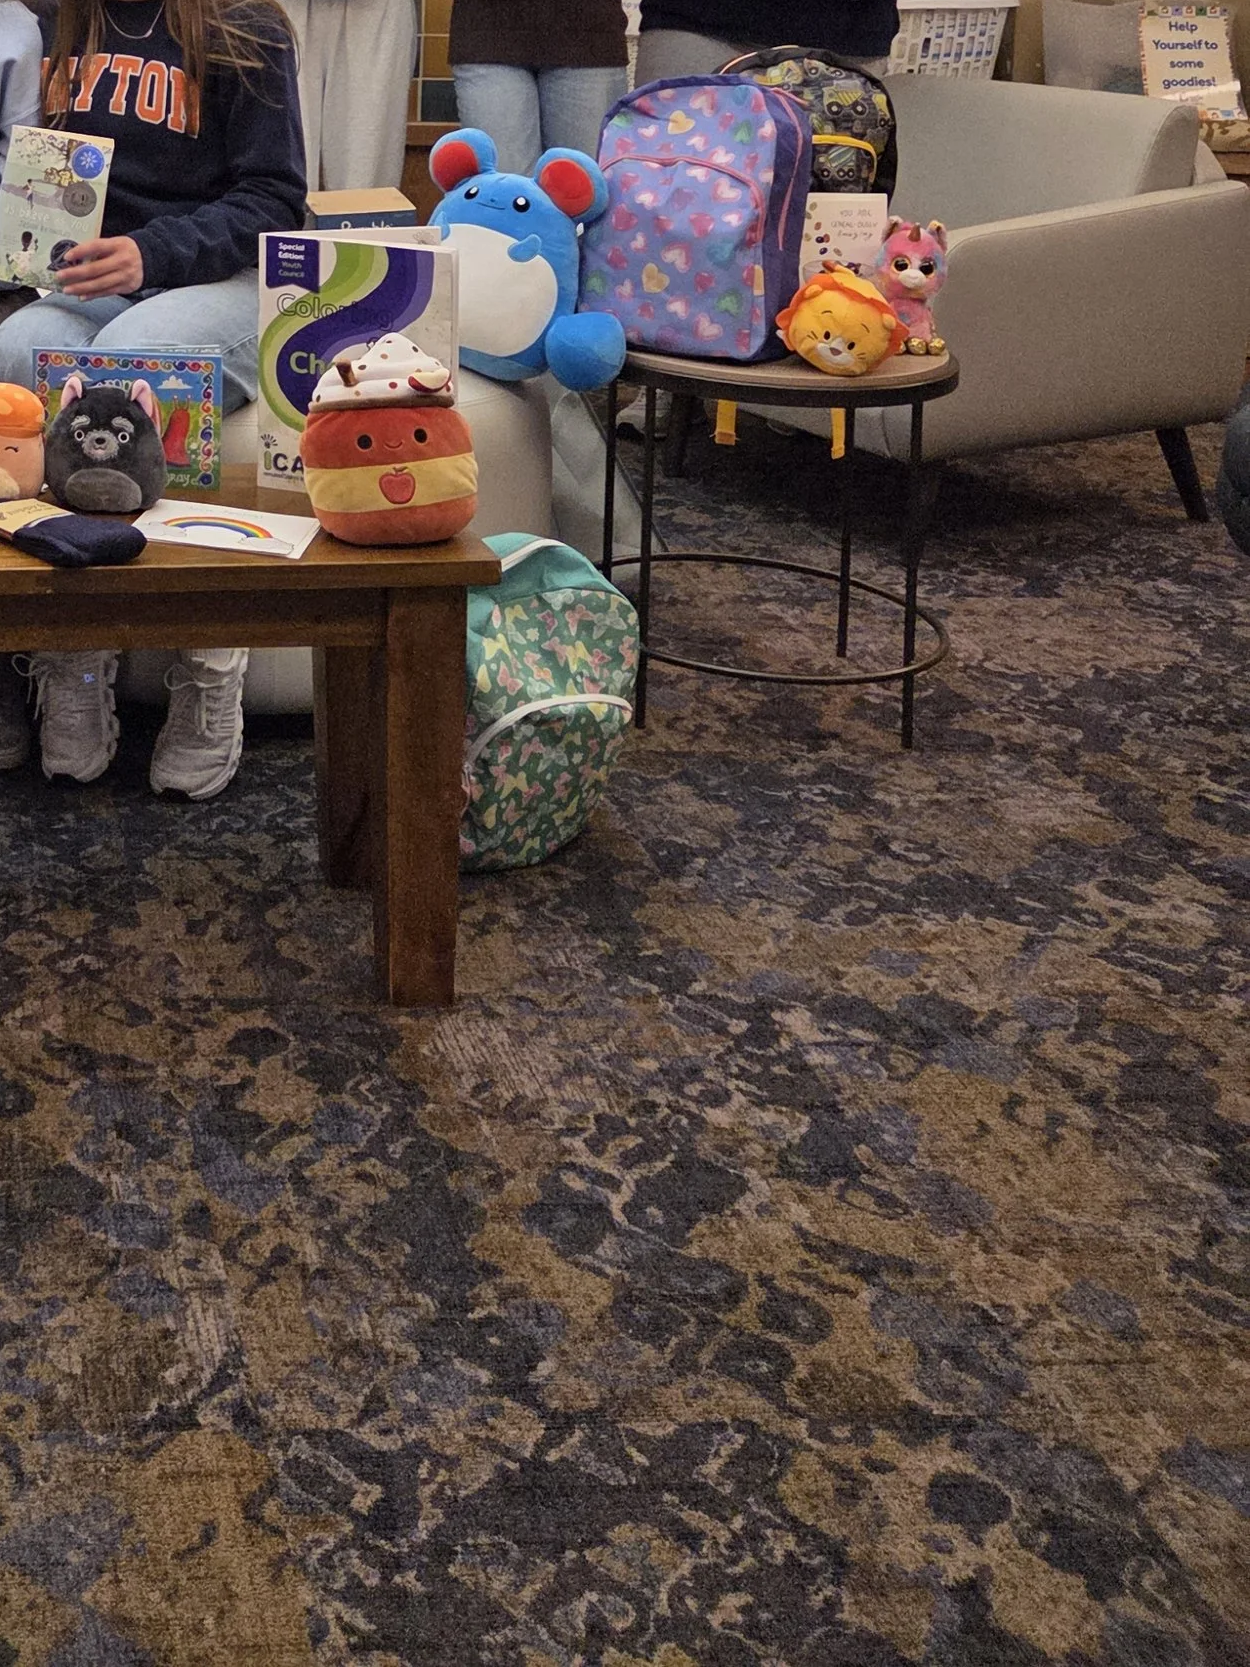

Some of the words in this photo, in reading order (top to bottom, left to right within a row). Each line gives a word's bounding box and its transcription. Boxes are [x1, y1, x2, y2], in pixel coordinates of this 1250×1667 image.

[1168, 21, 1198, 34] Help
[1152, 39, 1203, 50] Yourself
[1205, 40, 1218, 50] to
[1169, 60, 1204, 69] some
[1162, 76, 1216, 89] goodies!
[40, 53, 199, 139] YTON
[278, 242, 305, 251] Special
[263, 442, 304, 474] iCA
